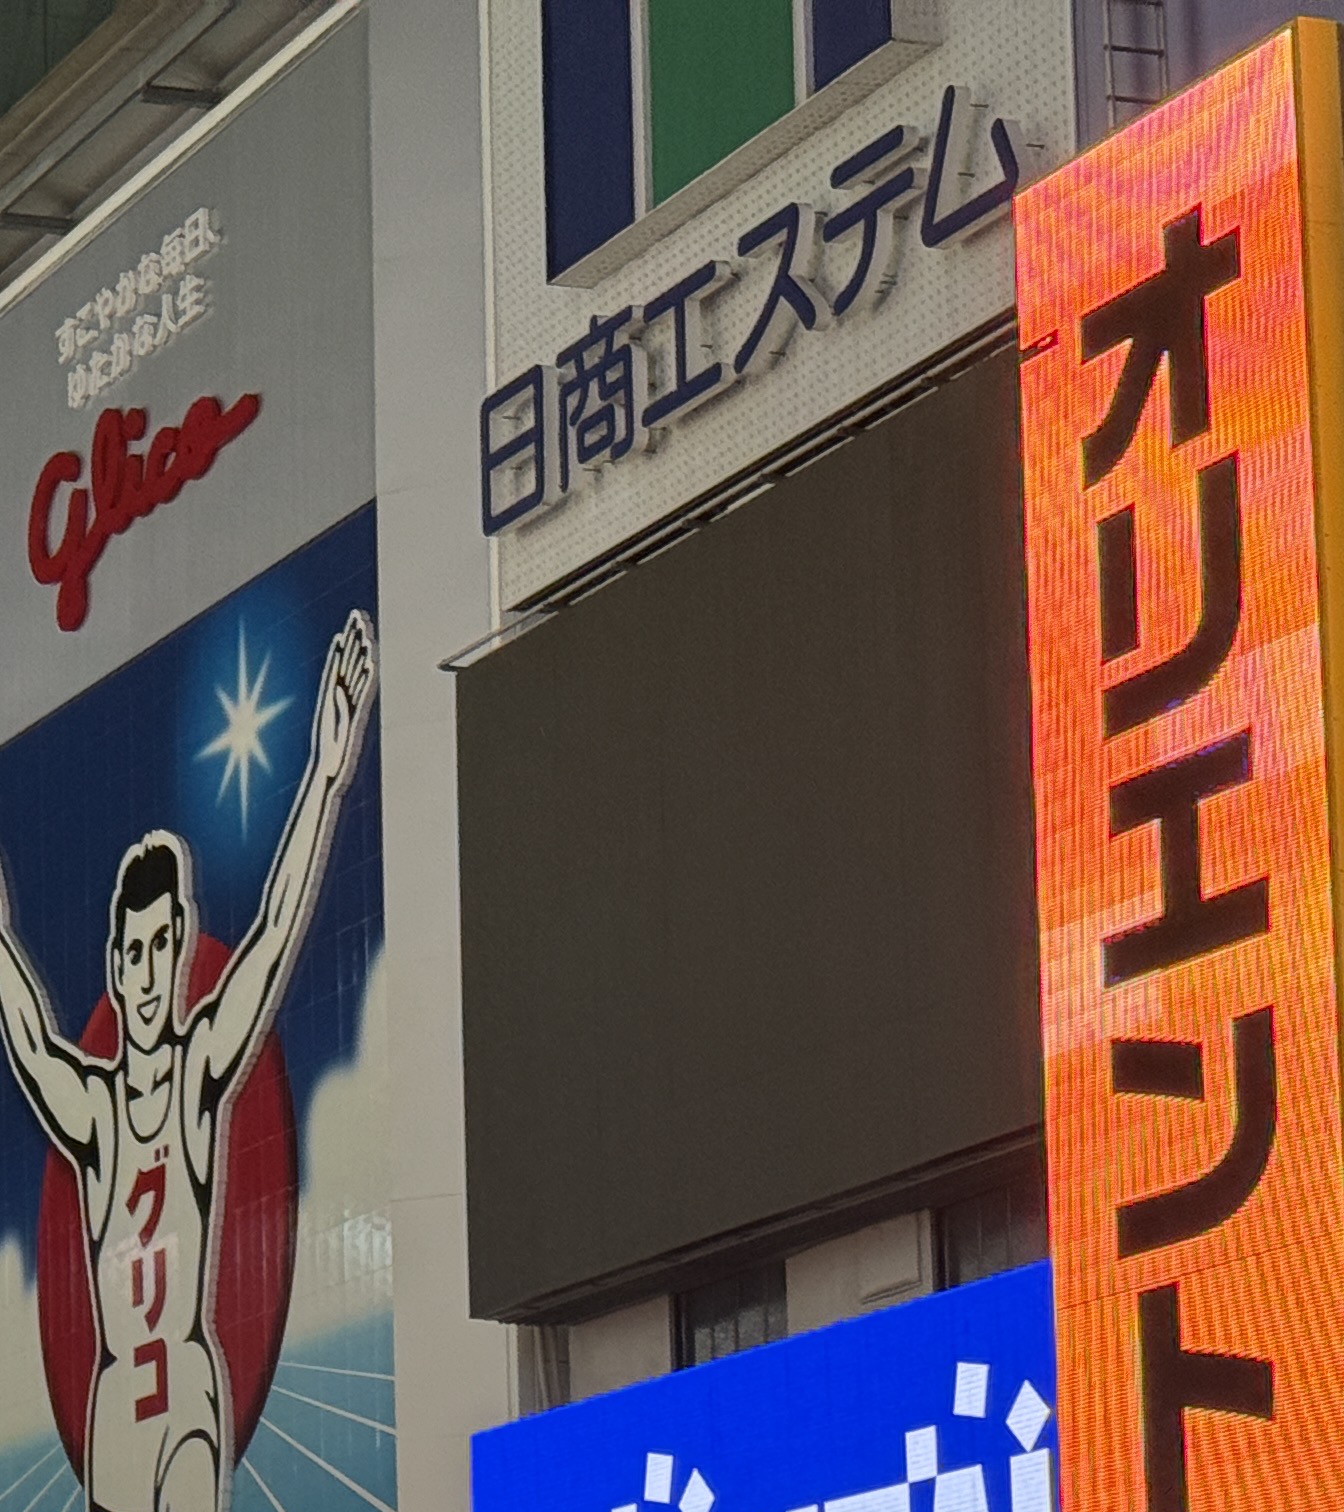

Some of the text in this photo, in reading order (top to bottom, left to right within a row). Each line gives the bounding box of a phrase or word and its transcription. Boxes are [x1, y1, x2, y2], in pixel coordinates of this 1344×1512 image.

[67, 275, 208, 409] ゆたかな人生
[481, 84, 1020, 538] 日商エステム
[27, 393, 261, 633] Glico
[125, 1144, 170, 1424] グリコ
